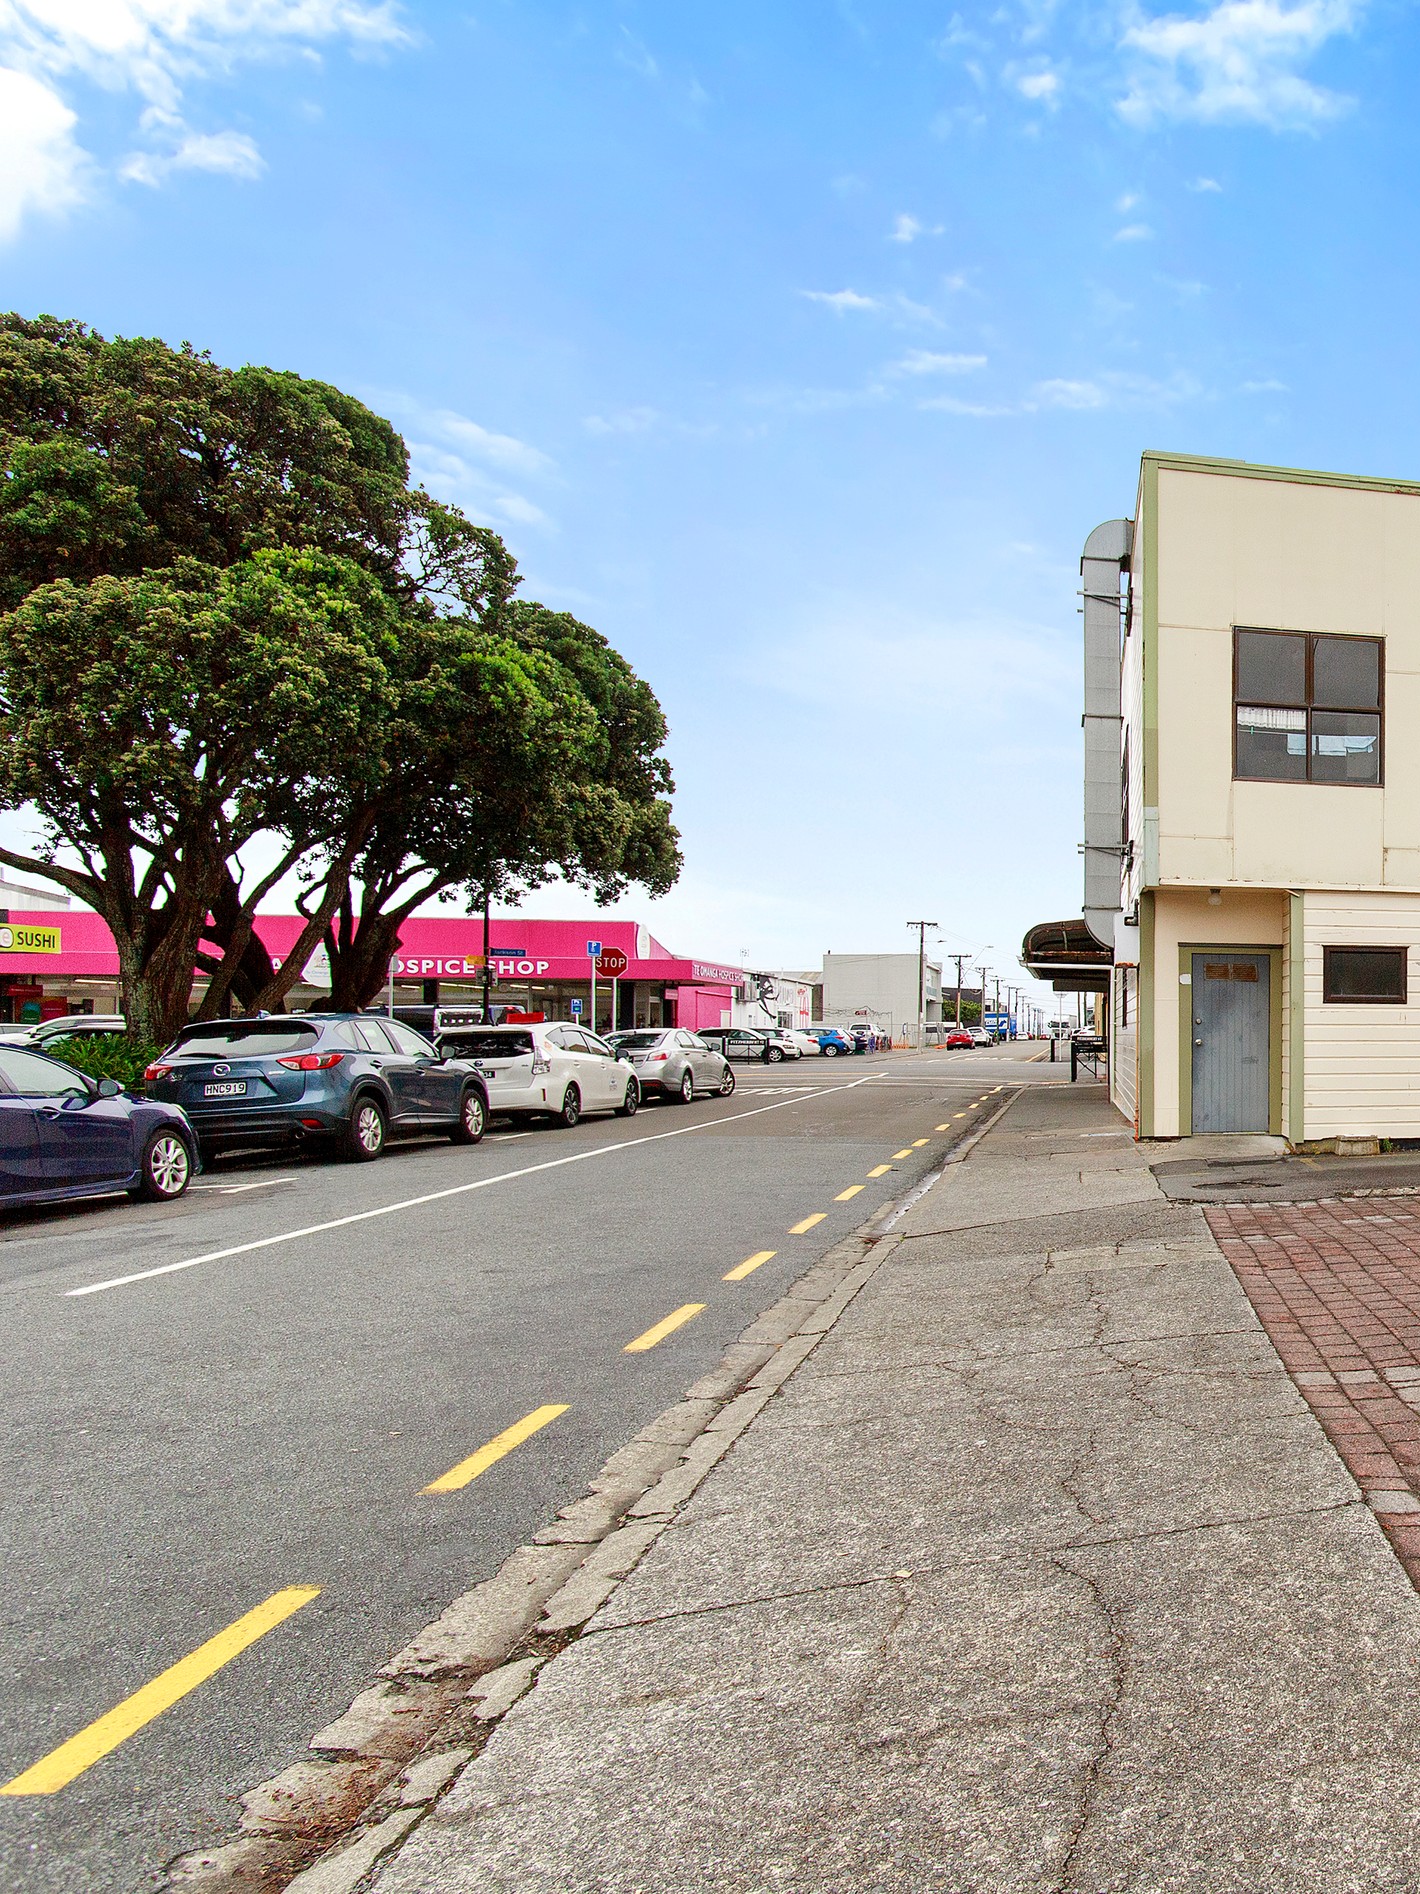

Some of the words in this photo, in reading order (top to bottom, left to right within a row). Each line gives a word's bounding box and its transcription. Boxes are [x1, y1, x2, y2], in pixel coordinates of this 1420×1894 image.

[17, 931, 55, 948] SUSHI
[596, 957, 626, 968] STOP
[206, 1083, 245, 1094] HNC919
